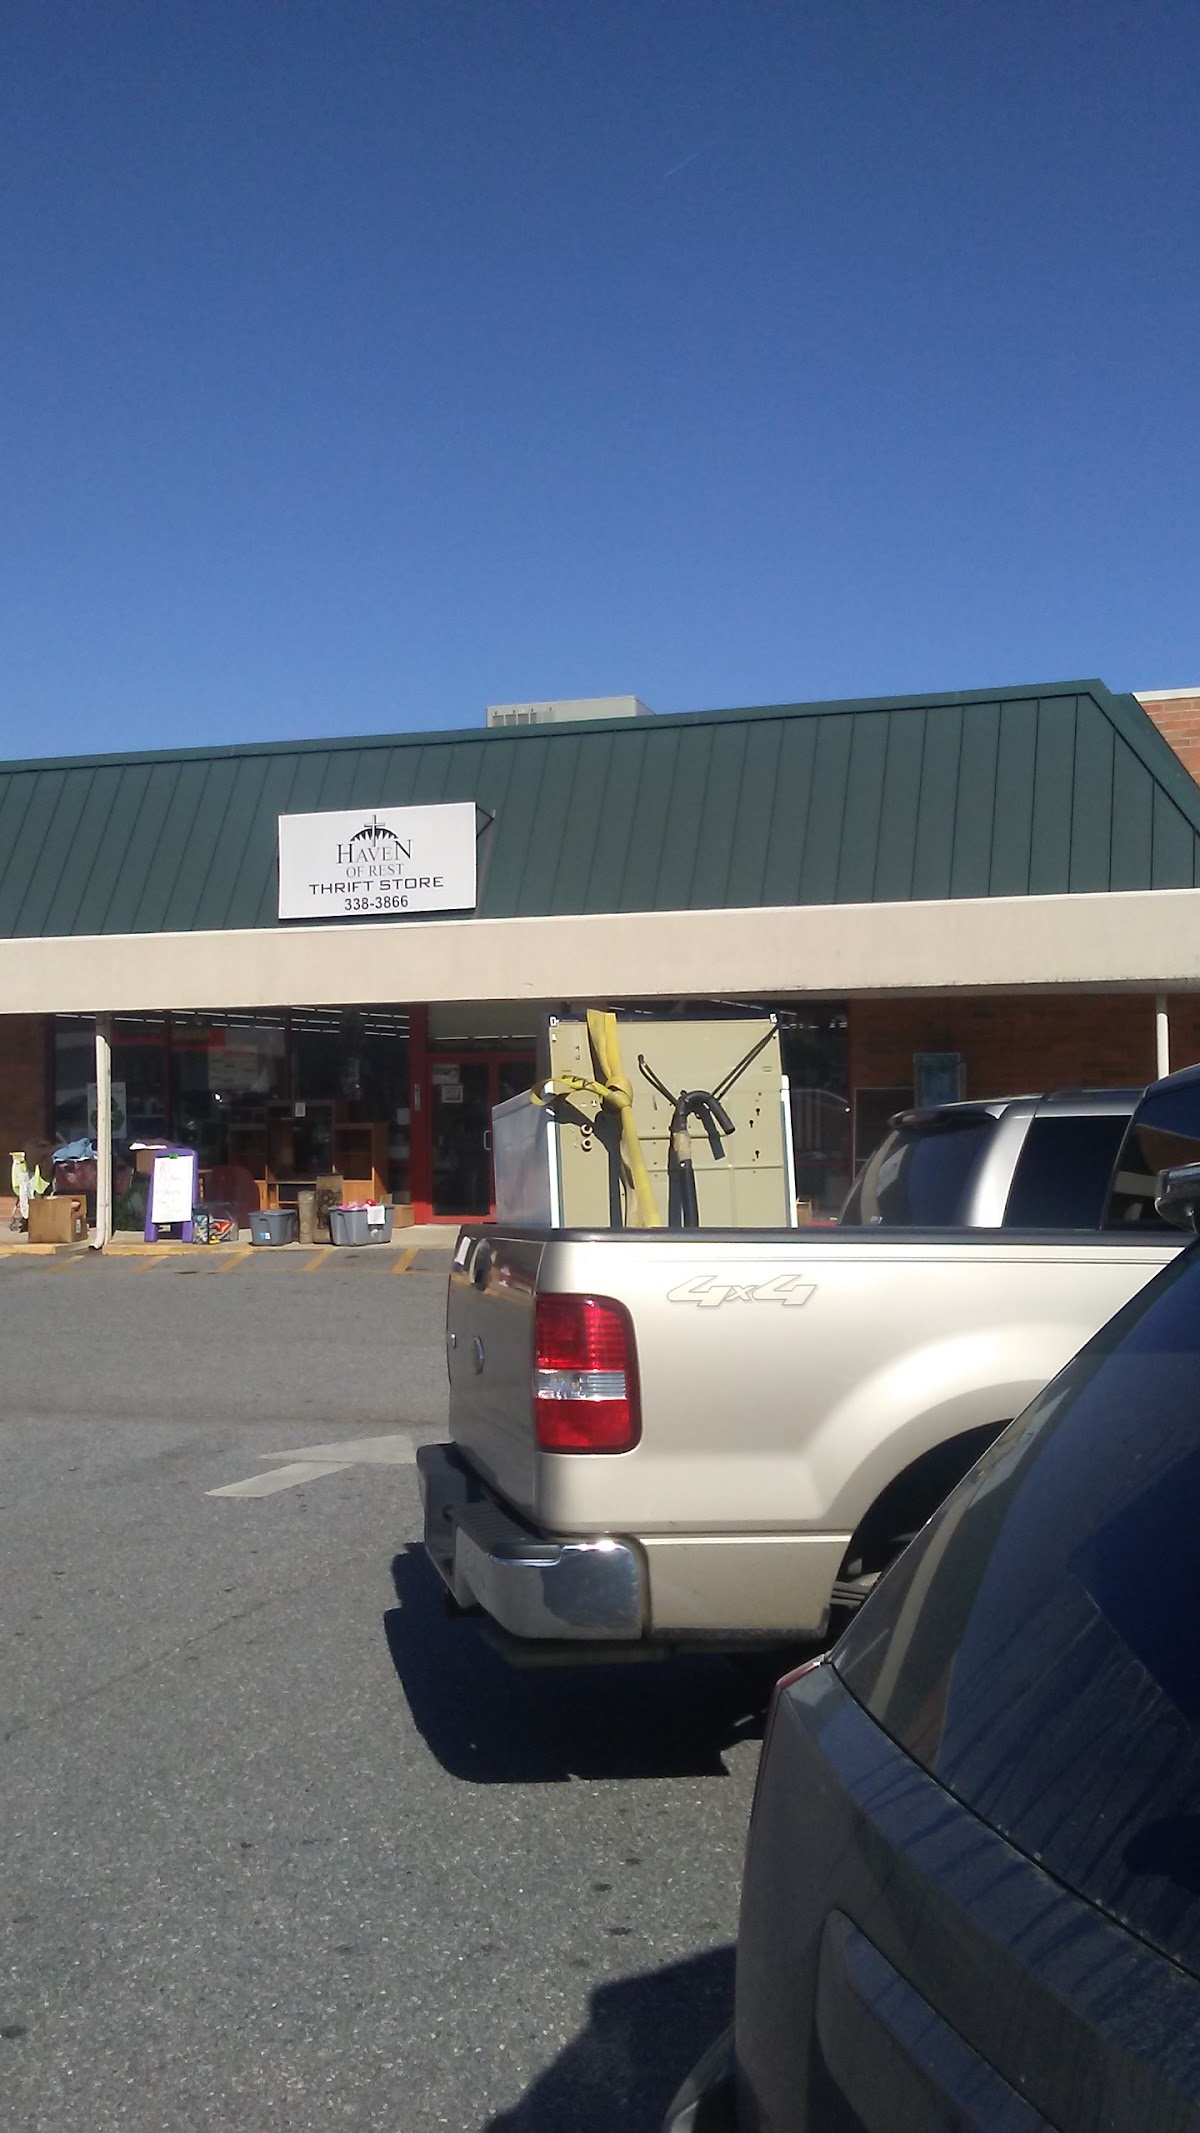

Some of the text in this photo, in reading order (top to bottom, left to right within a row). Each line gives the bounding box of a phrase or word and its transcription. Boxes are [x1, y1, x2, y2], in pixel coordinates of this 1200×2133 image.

[336, 839, 413, 864] HAVEN
[346, 863, 404, 878] OF REST
[309, 876, 444, 895] THRIFT STORE
[344, 895, 409, 911] 338-3866
[666, 1274, 818, 1308] 4x4
